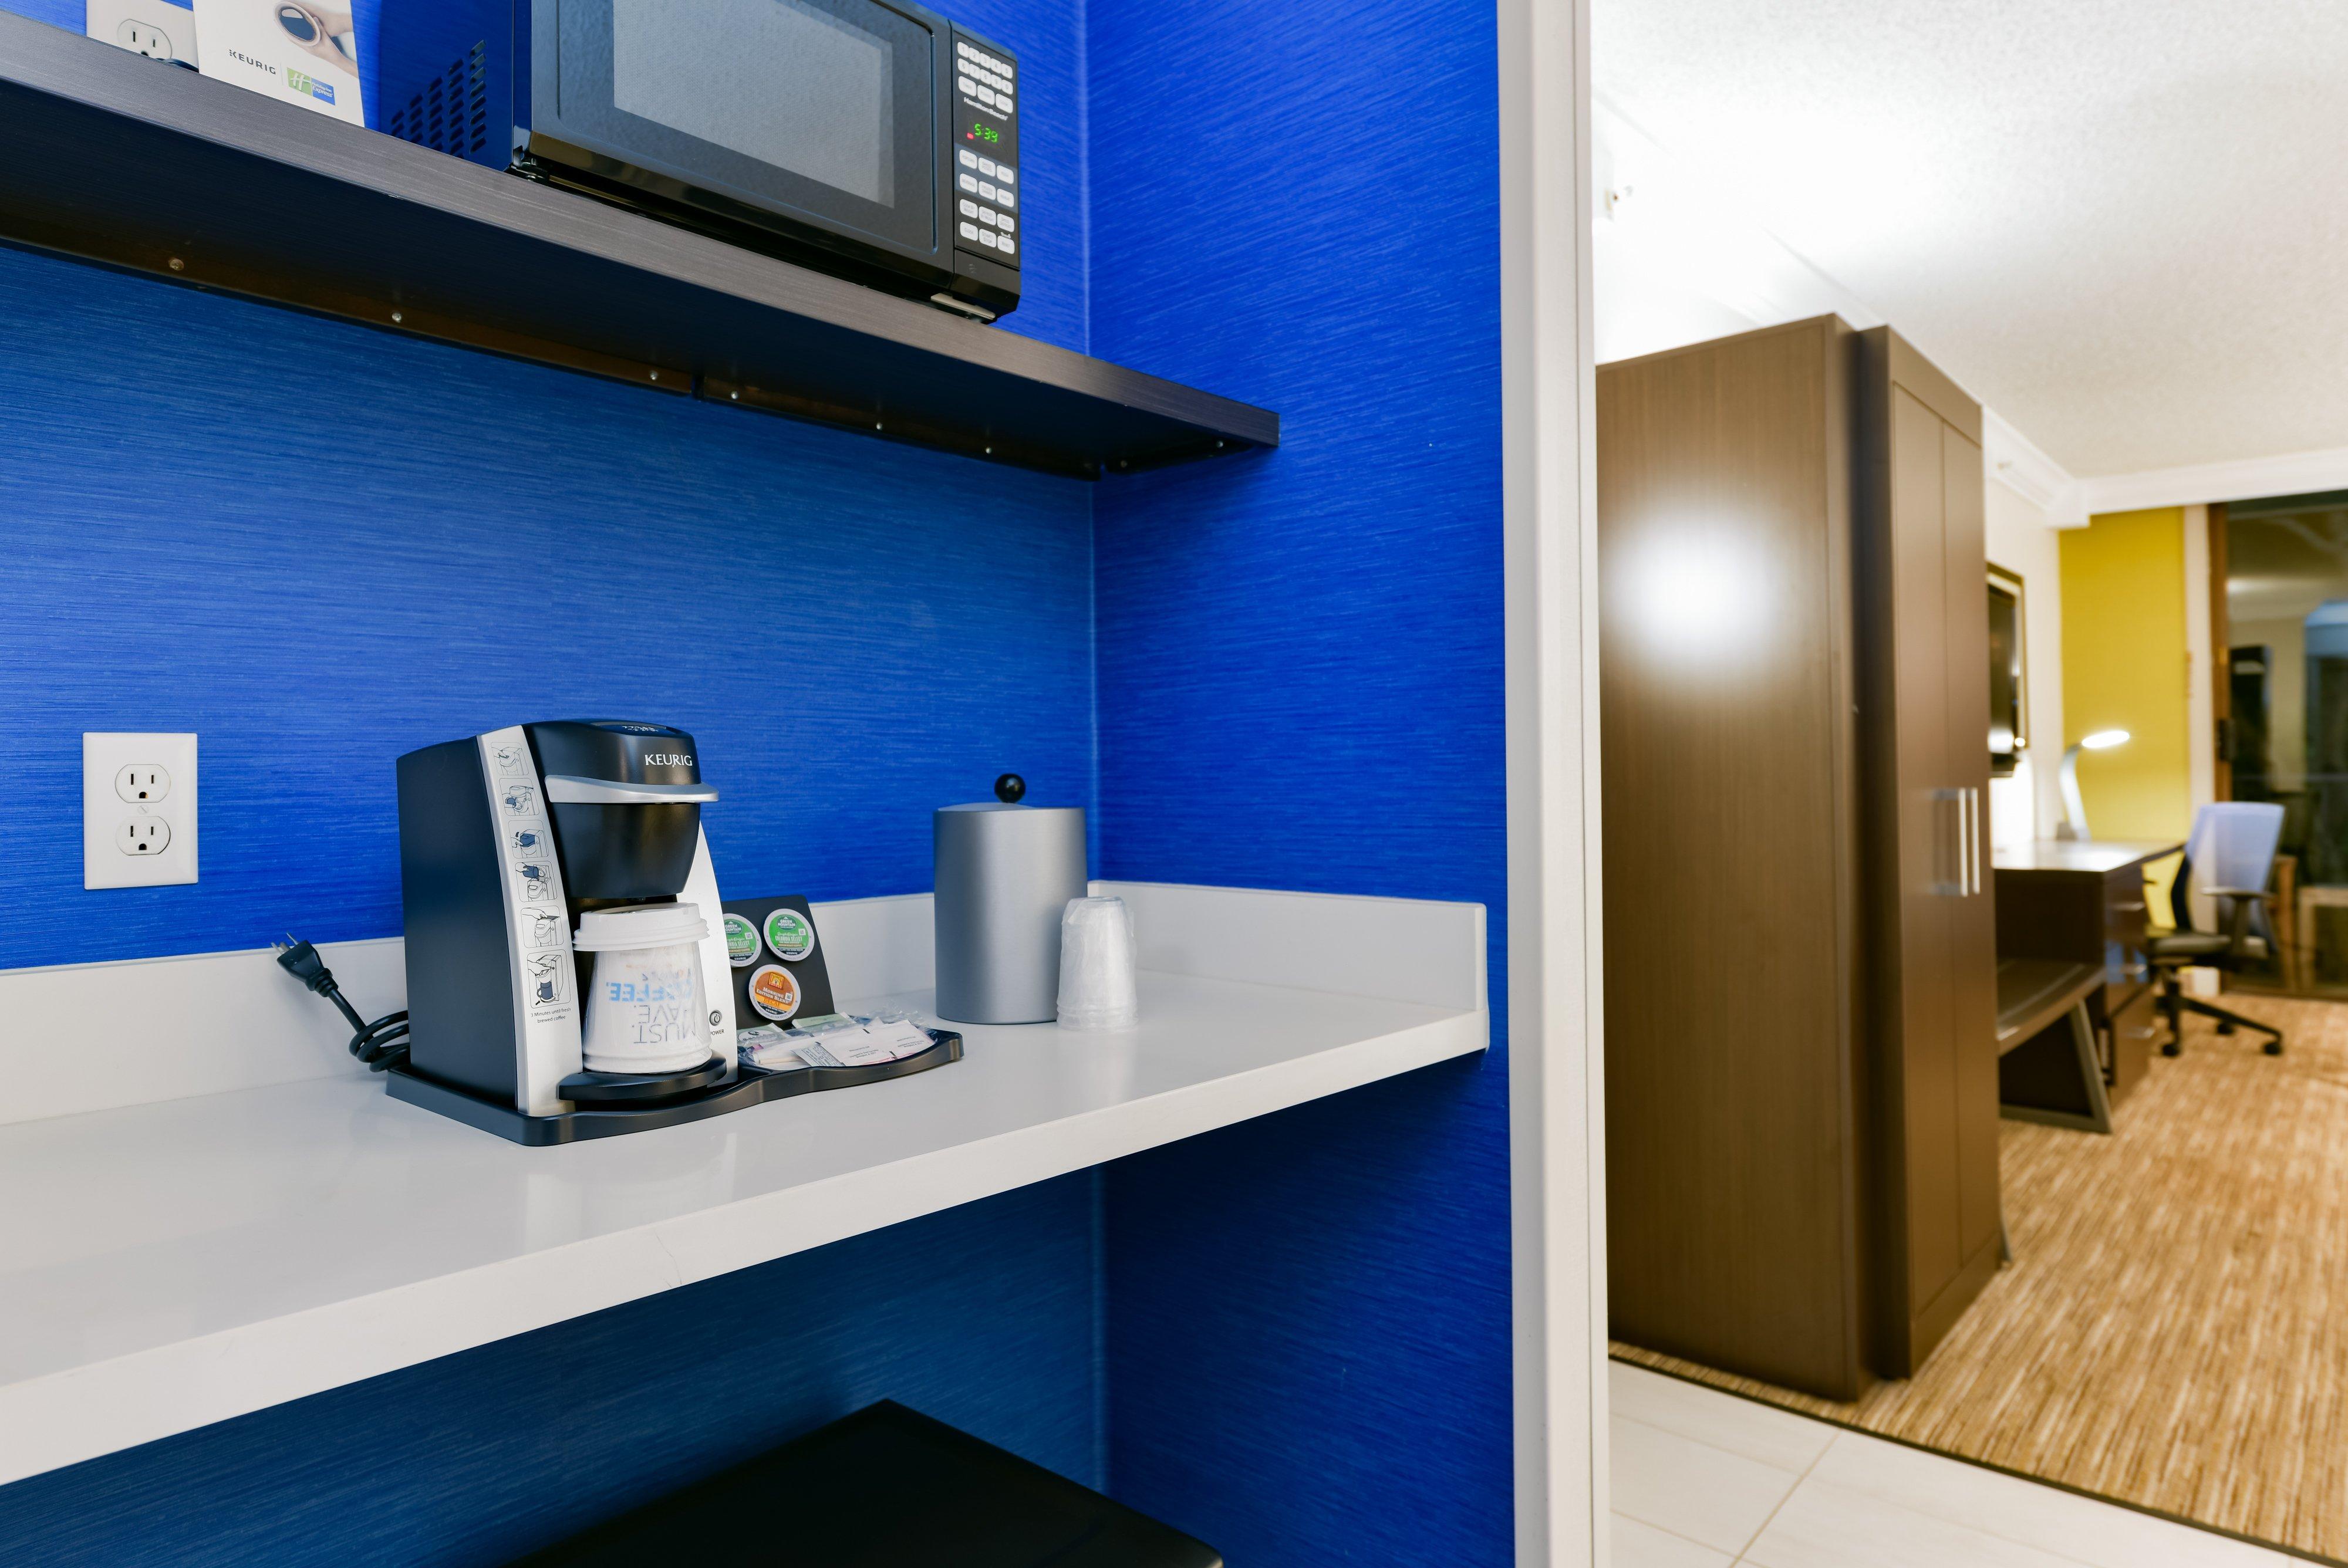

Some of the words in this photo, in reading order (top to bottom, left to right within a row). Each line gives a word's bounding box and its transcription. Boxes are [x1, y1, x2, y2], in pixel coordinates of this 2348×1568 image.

[229, 49, 276, 75] KEURIG
[312, 82, 326, 91] Holiday
[312, 86, 333, 97] Express
[645, 754, 693, 768] KEURIG
[756, 988, 774, 999] EDITION
[774, 995, 790, 1004] BLEND
[763, 986, 784, 998] MORNING
[764, 998, 780, 1007] DECAF
